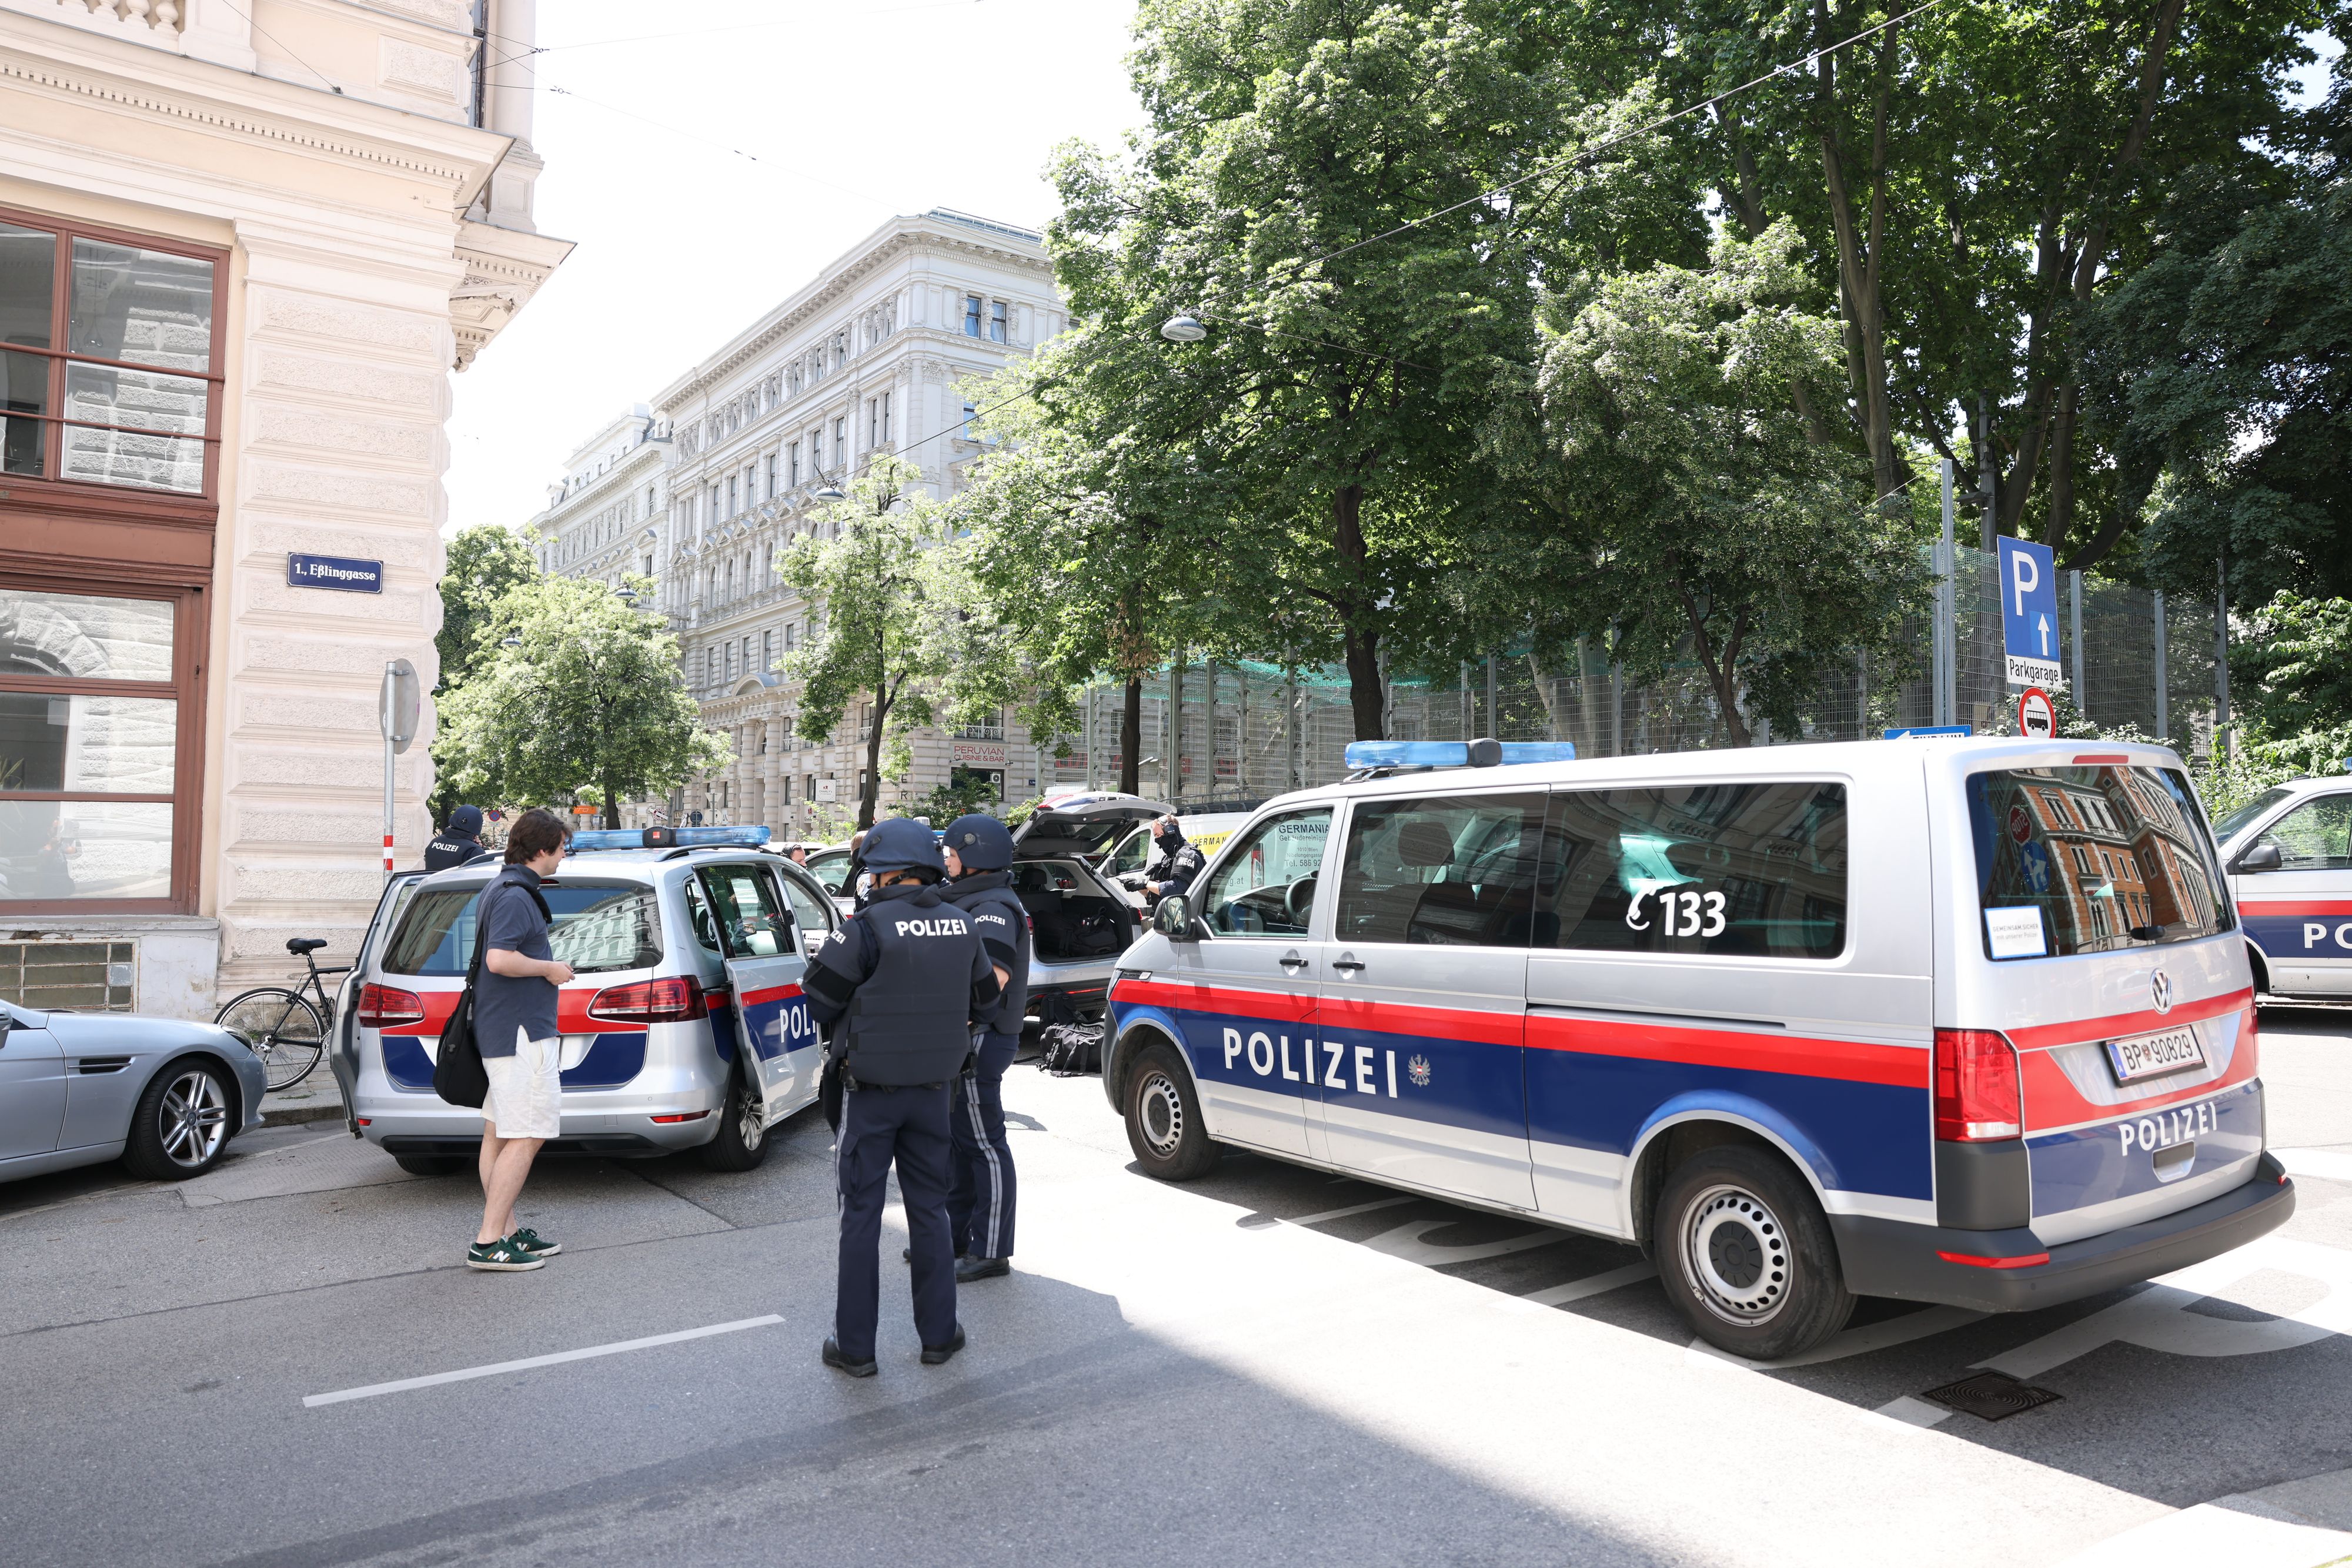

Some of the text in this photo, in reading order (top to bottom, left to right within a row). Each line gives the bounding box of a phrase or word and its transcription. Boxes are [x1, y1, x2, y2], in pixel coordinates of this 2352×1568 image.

[309, 564, 376, 580] Eßlinggasse
[2012, 550, 2039, 616] P
[2009, 658, 2058, 685] Parkgarage
[954, 746, 1004, 755] PERUVIAN
[1279, 824, 1329, 834] GERMANIA
[432, 842, 459, 852] POLIZEI
[1177, 857, 1195, 869] WEGA
[974, 915, 1005, 925] POLIZEI
[1659, 891, 1726, 937] 133
[895, 919, 968, 937] POLIZEI
[2122, 1034, 2193, 1070] BP 90829
[1223, 1027, 1398, 1098] POLIZEI
[2118, 1101, 2217, 1156] POLIZEI
